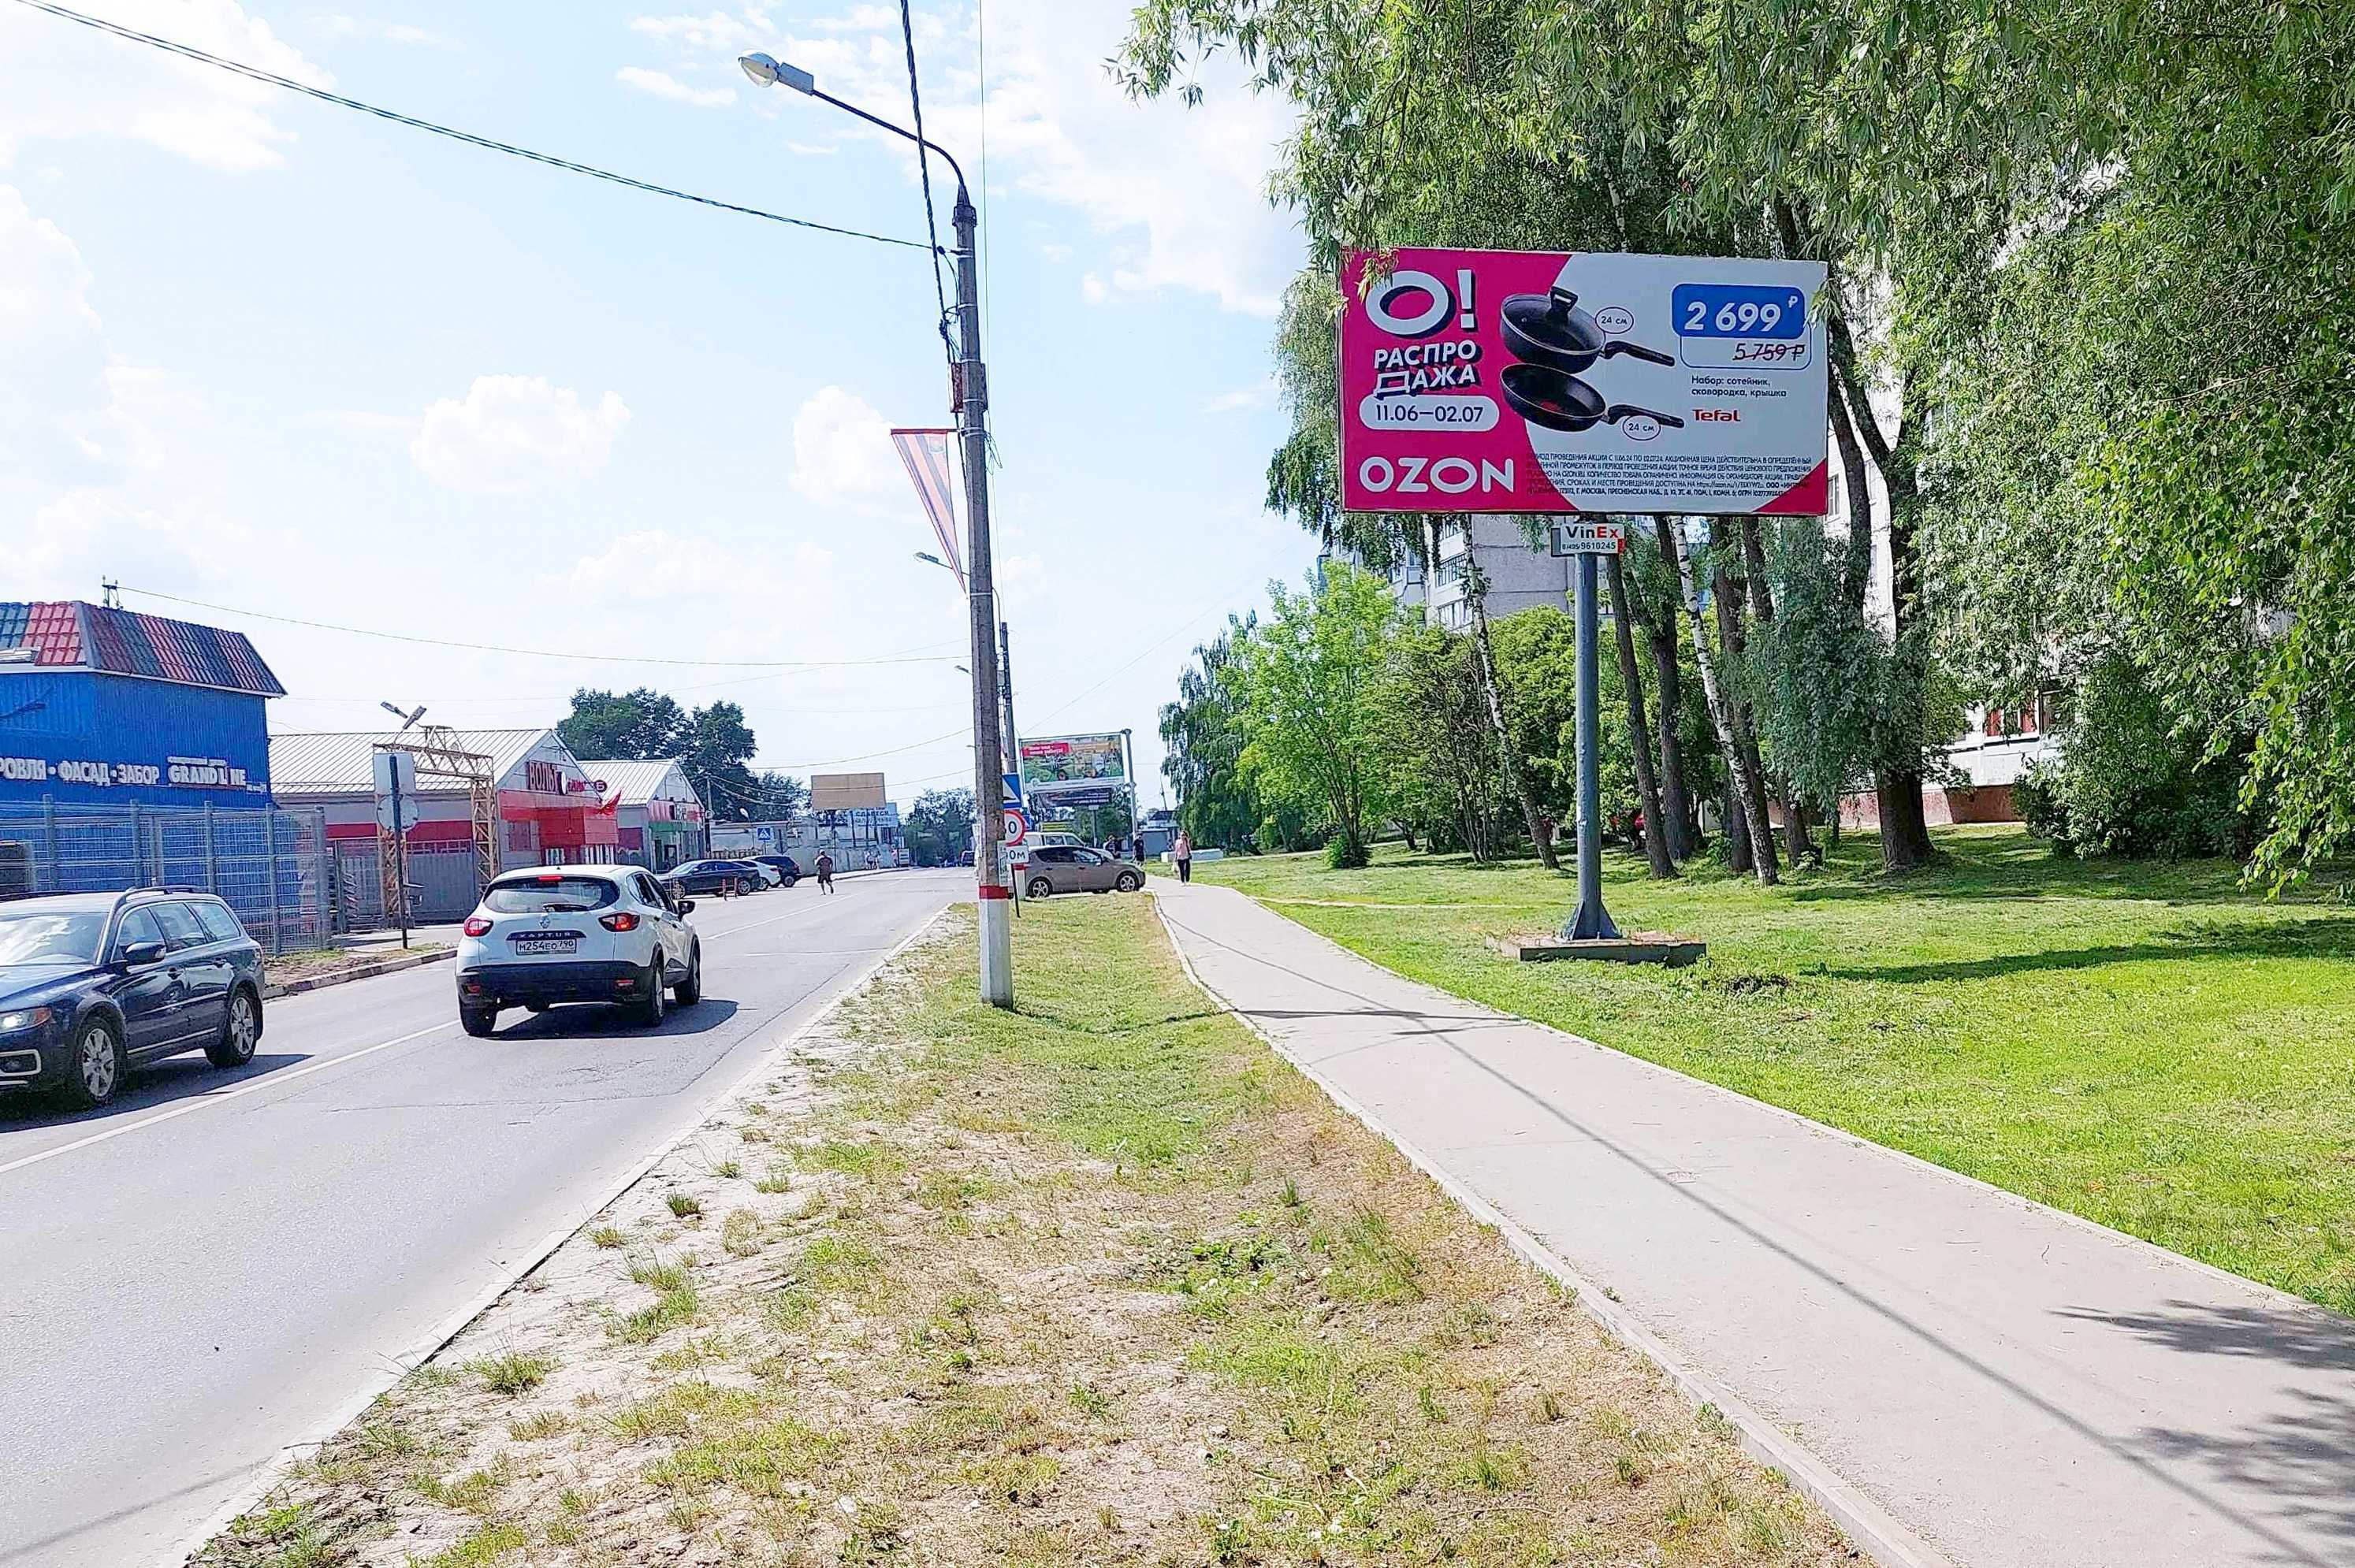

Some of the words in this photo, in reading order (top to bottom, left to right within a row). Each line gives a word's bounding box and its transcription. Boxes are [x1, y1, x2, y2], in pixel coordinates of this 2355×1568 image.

[1601, 316, 1613, 325] 24
[1373, 339, 1477, 370] РАСПРО
[1373, 364, 1476, 396] ДАЖА
[1691, 375, 1724, 386] Набор:
[1726, 377, 1771, 386] сотейник,
[1691, 388, 1747, 397] сковородка,
[1692, 408, 1742, 422] Tefal
[1628, 422, 1640, 431] 24
[1360, 455, 1515, 493] OZON
[1565, 526, 1619, 539] VinEx
[58, 760, 110, 786] ФАСАД
[117, 764, 159, 785] ЗАБОР
